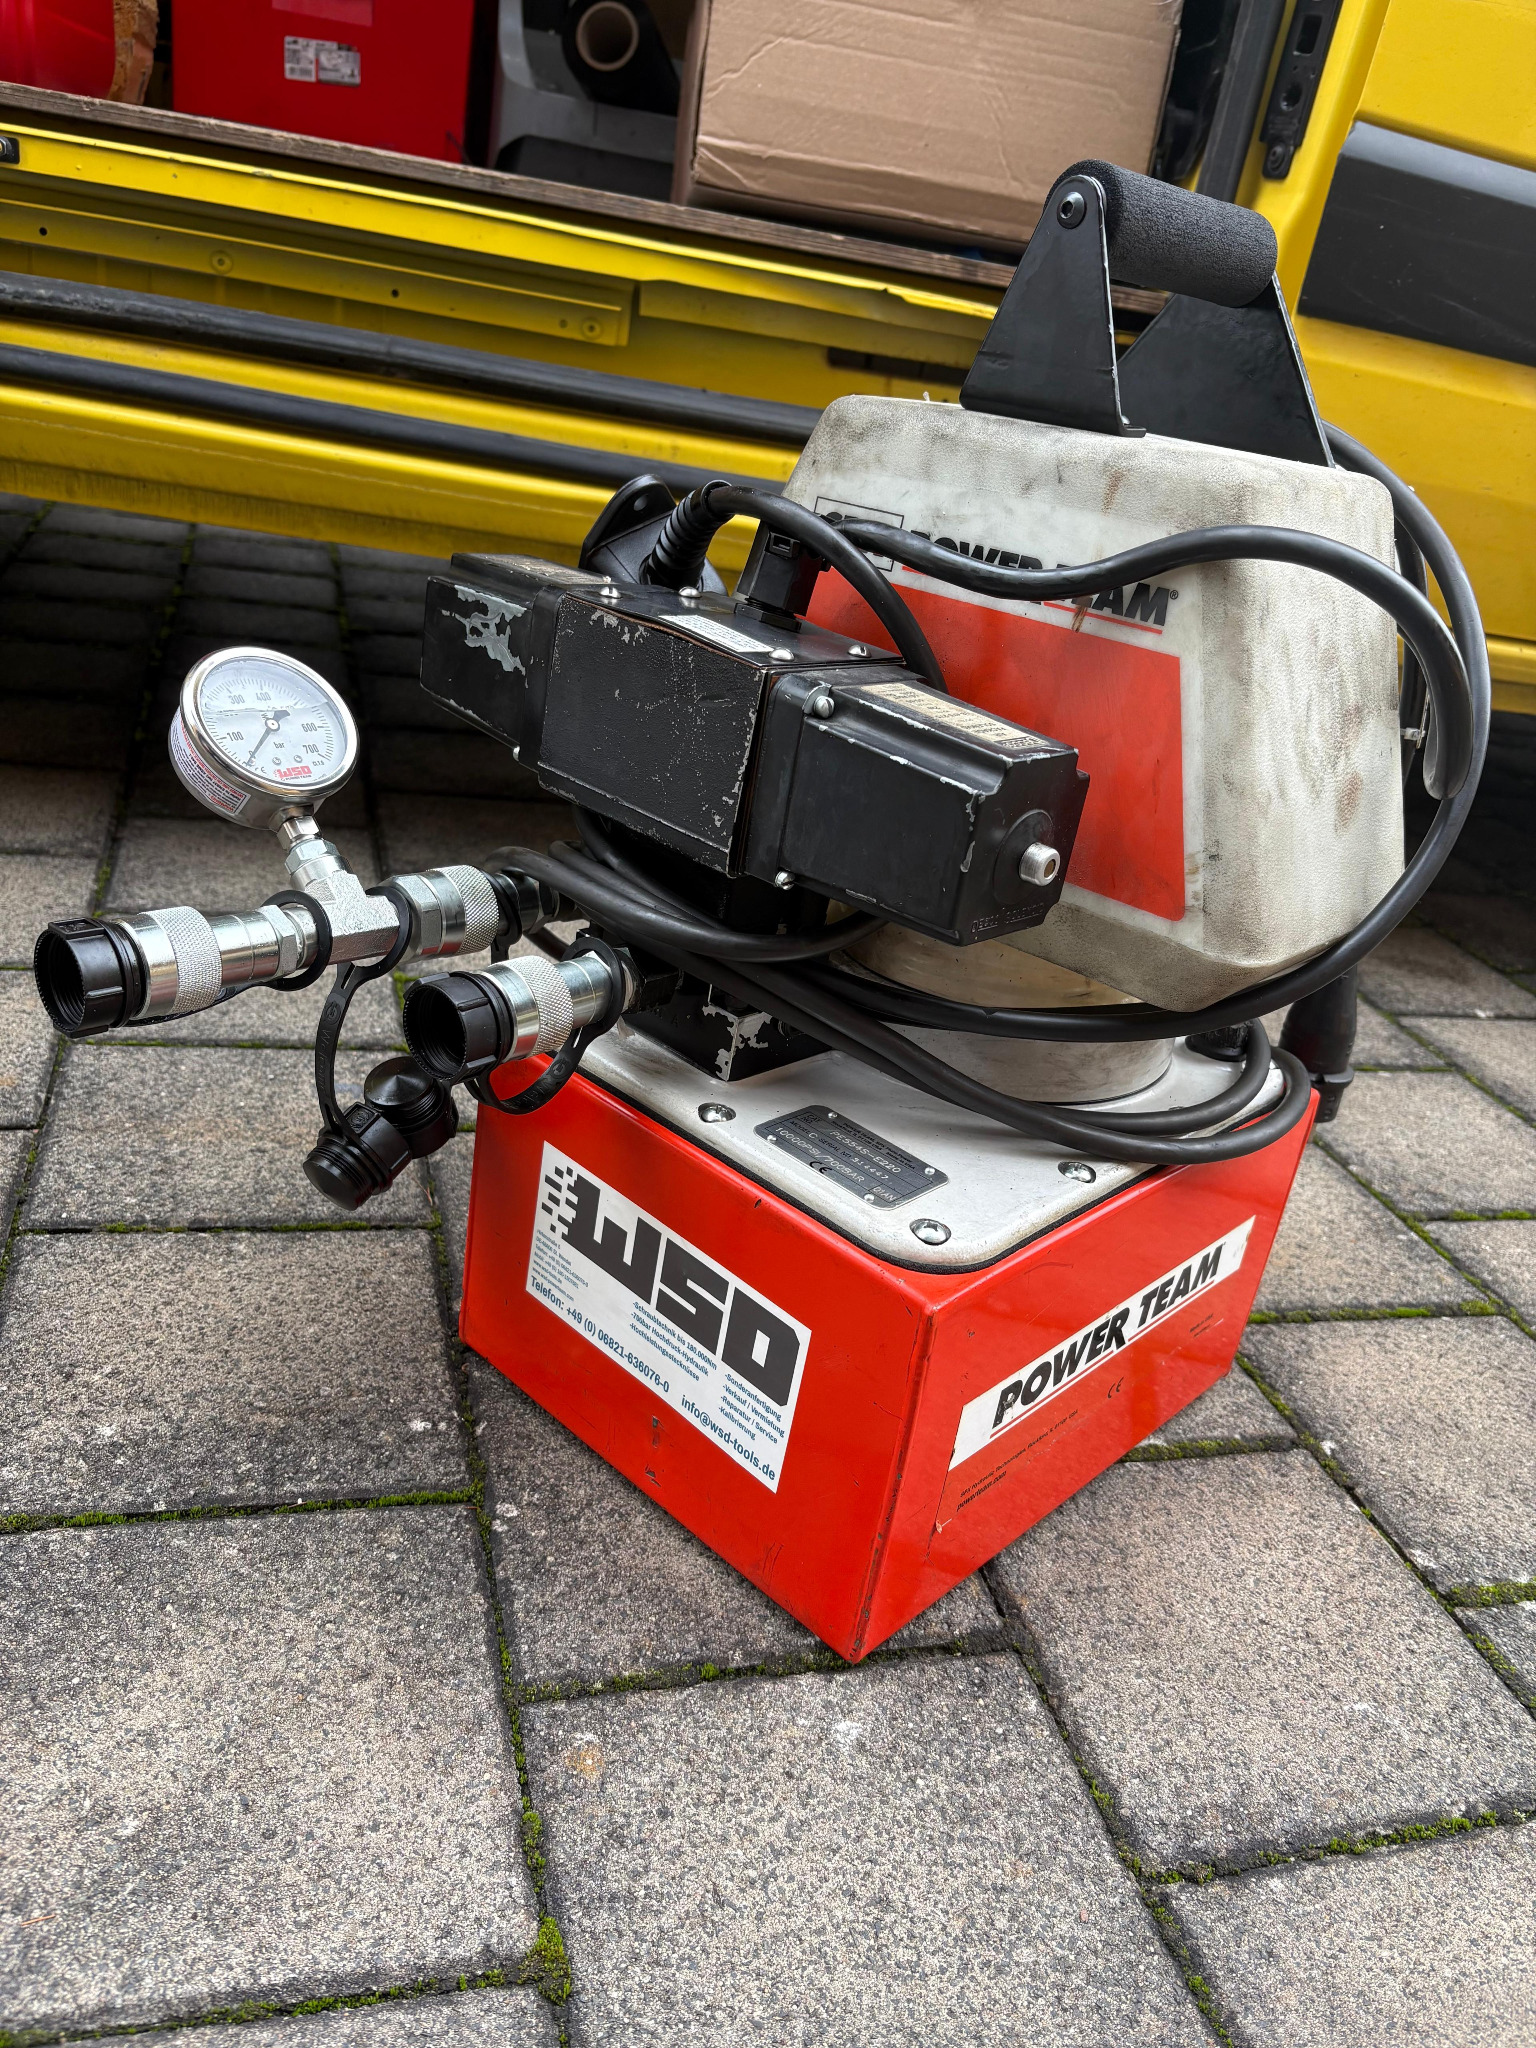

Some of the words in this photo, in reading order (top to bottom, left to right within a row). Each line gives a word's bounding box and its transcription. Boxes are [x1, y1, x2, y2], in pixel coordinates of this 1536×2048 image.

[228, 694, 245, 705] 300
[256, 691, 271, 702] 400
[301, 722, 318, 733] 600
[226, 731, 244, 742] 100
[302, 744, 319, 754] 700
[274, 765, 313, 778] WSD
[542, 1166, 800, 1407] WSD
[531, 1274, 565, 1310] Telefon:
[566, 1307, 582, 1324] +49
[584, 1317, 597, 1337] (0)
[597, 1329, 670, 1393] 06821-636076-0
[676, 1334, 686, 1346] bis
[992, 1306, 1130, 1430] POWER
[1137, 1243, 1224, 1329] TEAM
[751, 1405, 785, 1438] Vermietung
[681, 1394, 776, 1481] info@wsd-tools.de
[755, 1421, 778, 1444] Service
